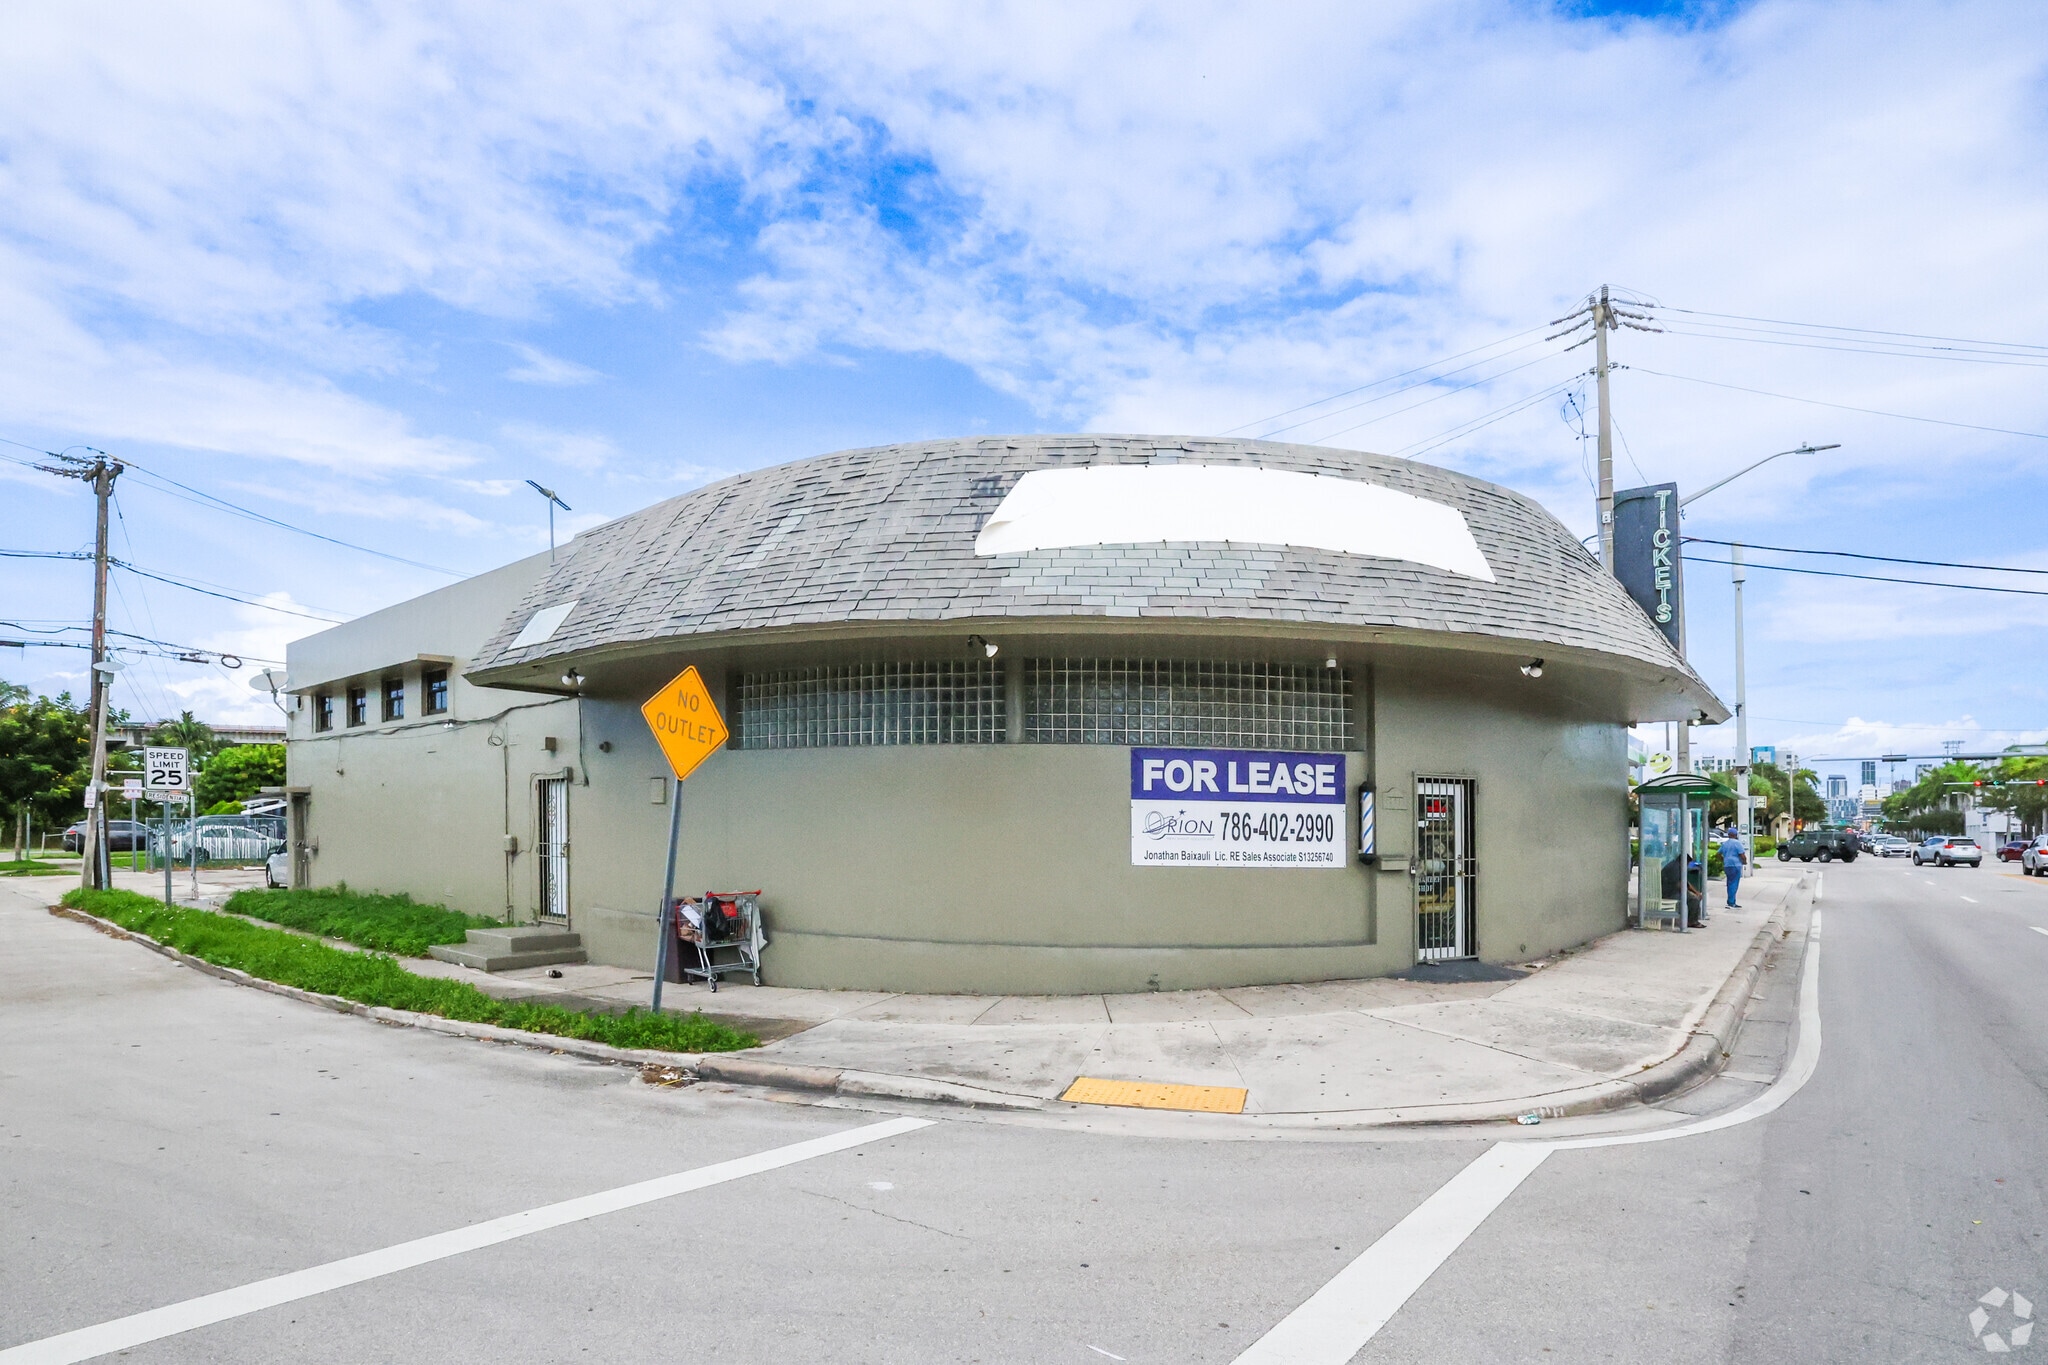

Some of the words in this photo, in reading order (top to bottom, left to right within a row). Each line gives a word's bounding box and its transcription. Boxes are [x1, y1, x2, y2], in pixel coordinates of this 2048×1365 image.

[1653, 490, 1672, 622] TICKETS
[678, 690, 699, 712] NO
[657, 712, 716, 745] OUTLET
[149, 752, 184, 760] SPEED
[151, 770, 182, 785] 25
[1142, 759, 1220, 793] FOR
[1228, 761, 1336, 796] LEASE
[1143, 810, 1214, 840] ORION
[1220, 812, 1334, 842] 786-402-2990
[1143, 850, 1179, 861] Jonathan
[1181, 850, 1211, 861] Baixauli
[1215, 851, 1228, 861] Lic.
[1229, 851, 1240, 861] RE
[1242, 851, 1262, 861] Sales
[1263, 852, 1297, 862] Associate
[1298, 852, 1334, 862] S13256740
